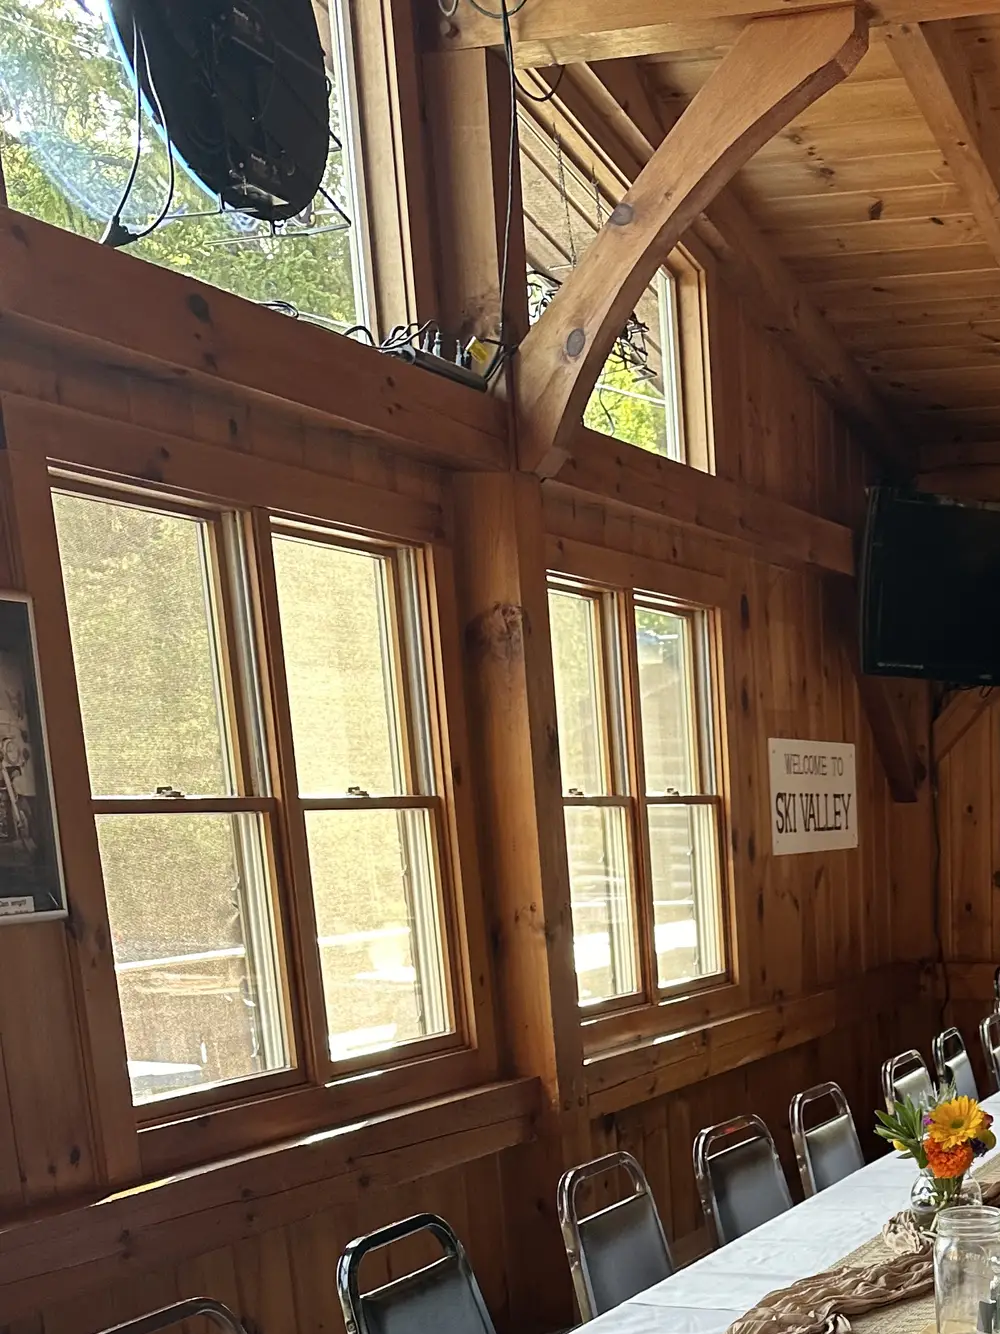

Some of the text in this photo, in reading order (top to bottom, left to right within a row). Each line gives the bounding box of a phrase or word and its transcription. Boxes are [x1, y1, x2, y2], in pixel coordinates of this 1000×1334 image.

[784, 753, 844, 777] WELCOME TO
[775, 792, 851, 834] SKI VALLEY
